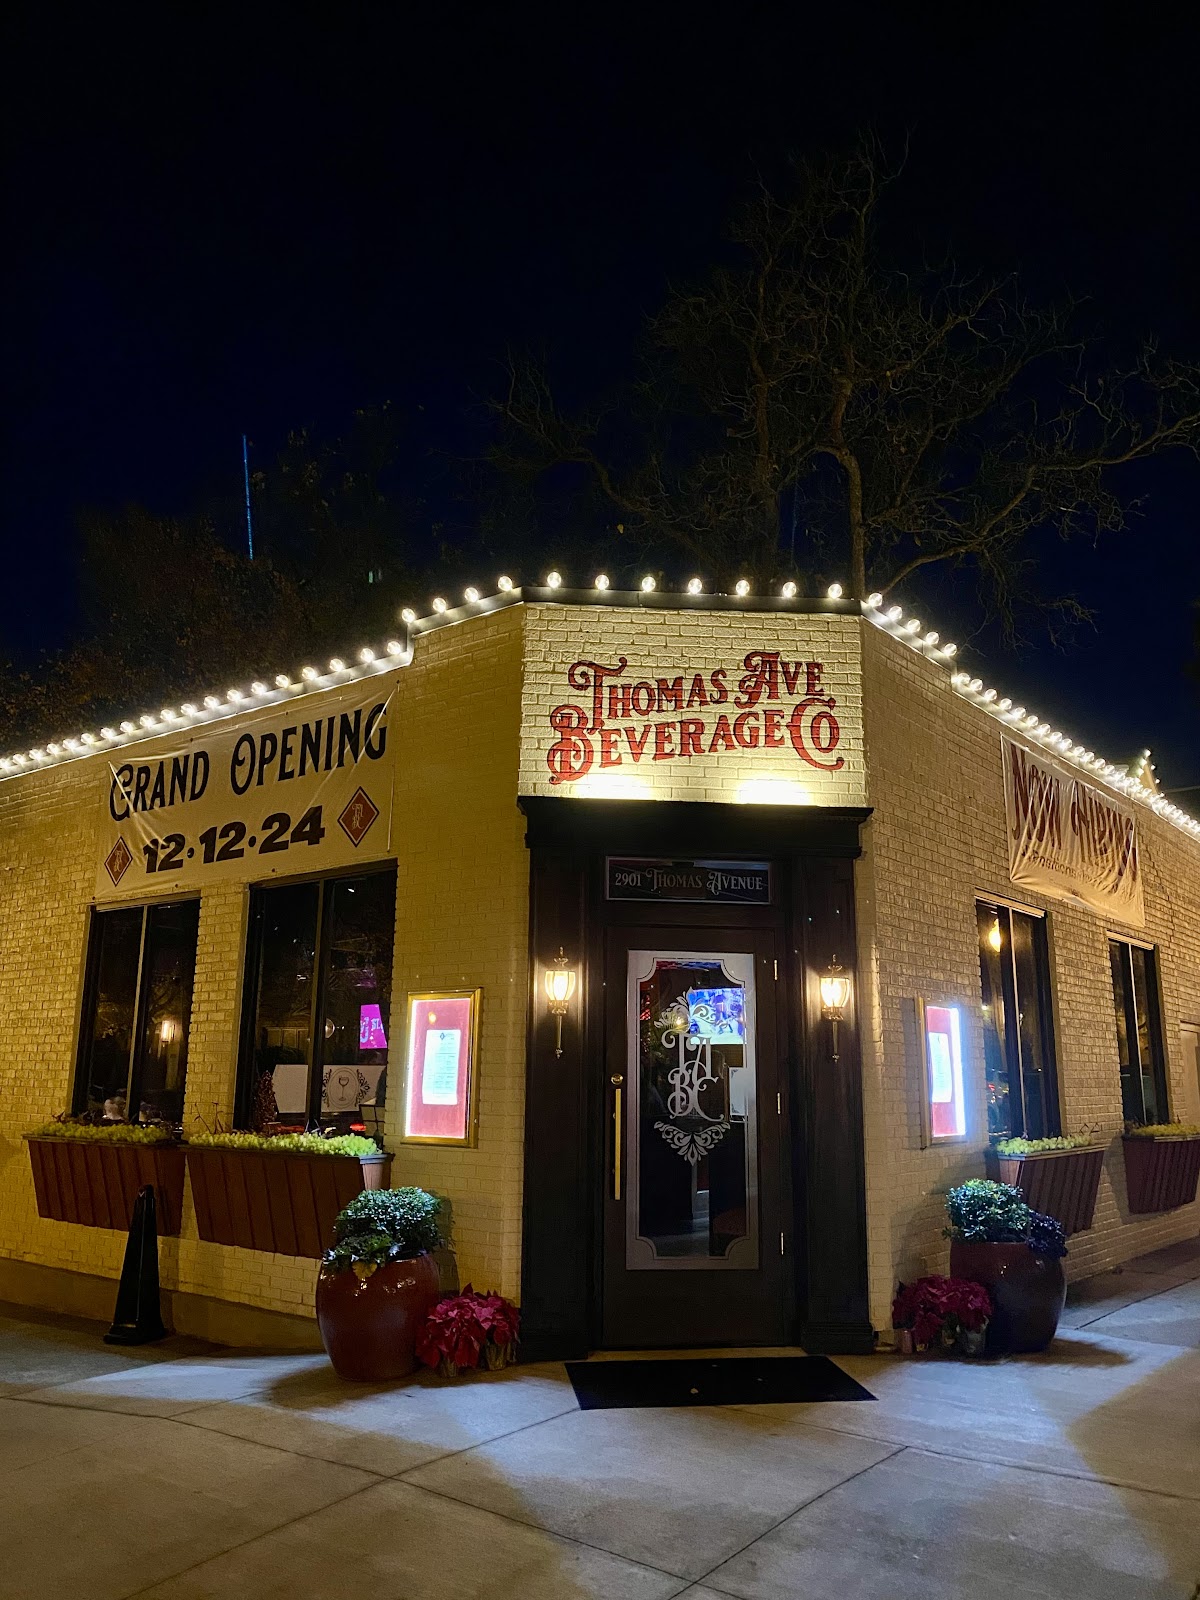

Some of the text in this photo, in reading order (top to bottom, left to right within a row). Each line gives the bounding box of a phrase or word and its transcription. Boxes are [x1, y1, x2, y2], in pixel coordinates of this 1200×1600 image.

[568, 651, 824, 734] THOMAS AVE
[109, 702, 387, 821] GRAND OPENING
[547, 698, 845, 784] BEVERAGE CO
[615, 868, 763, 895] 2901 THOMAS AVENUE
